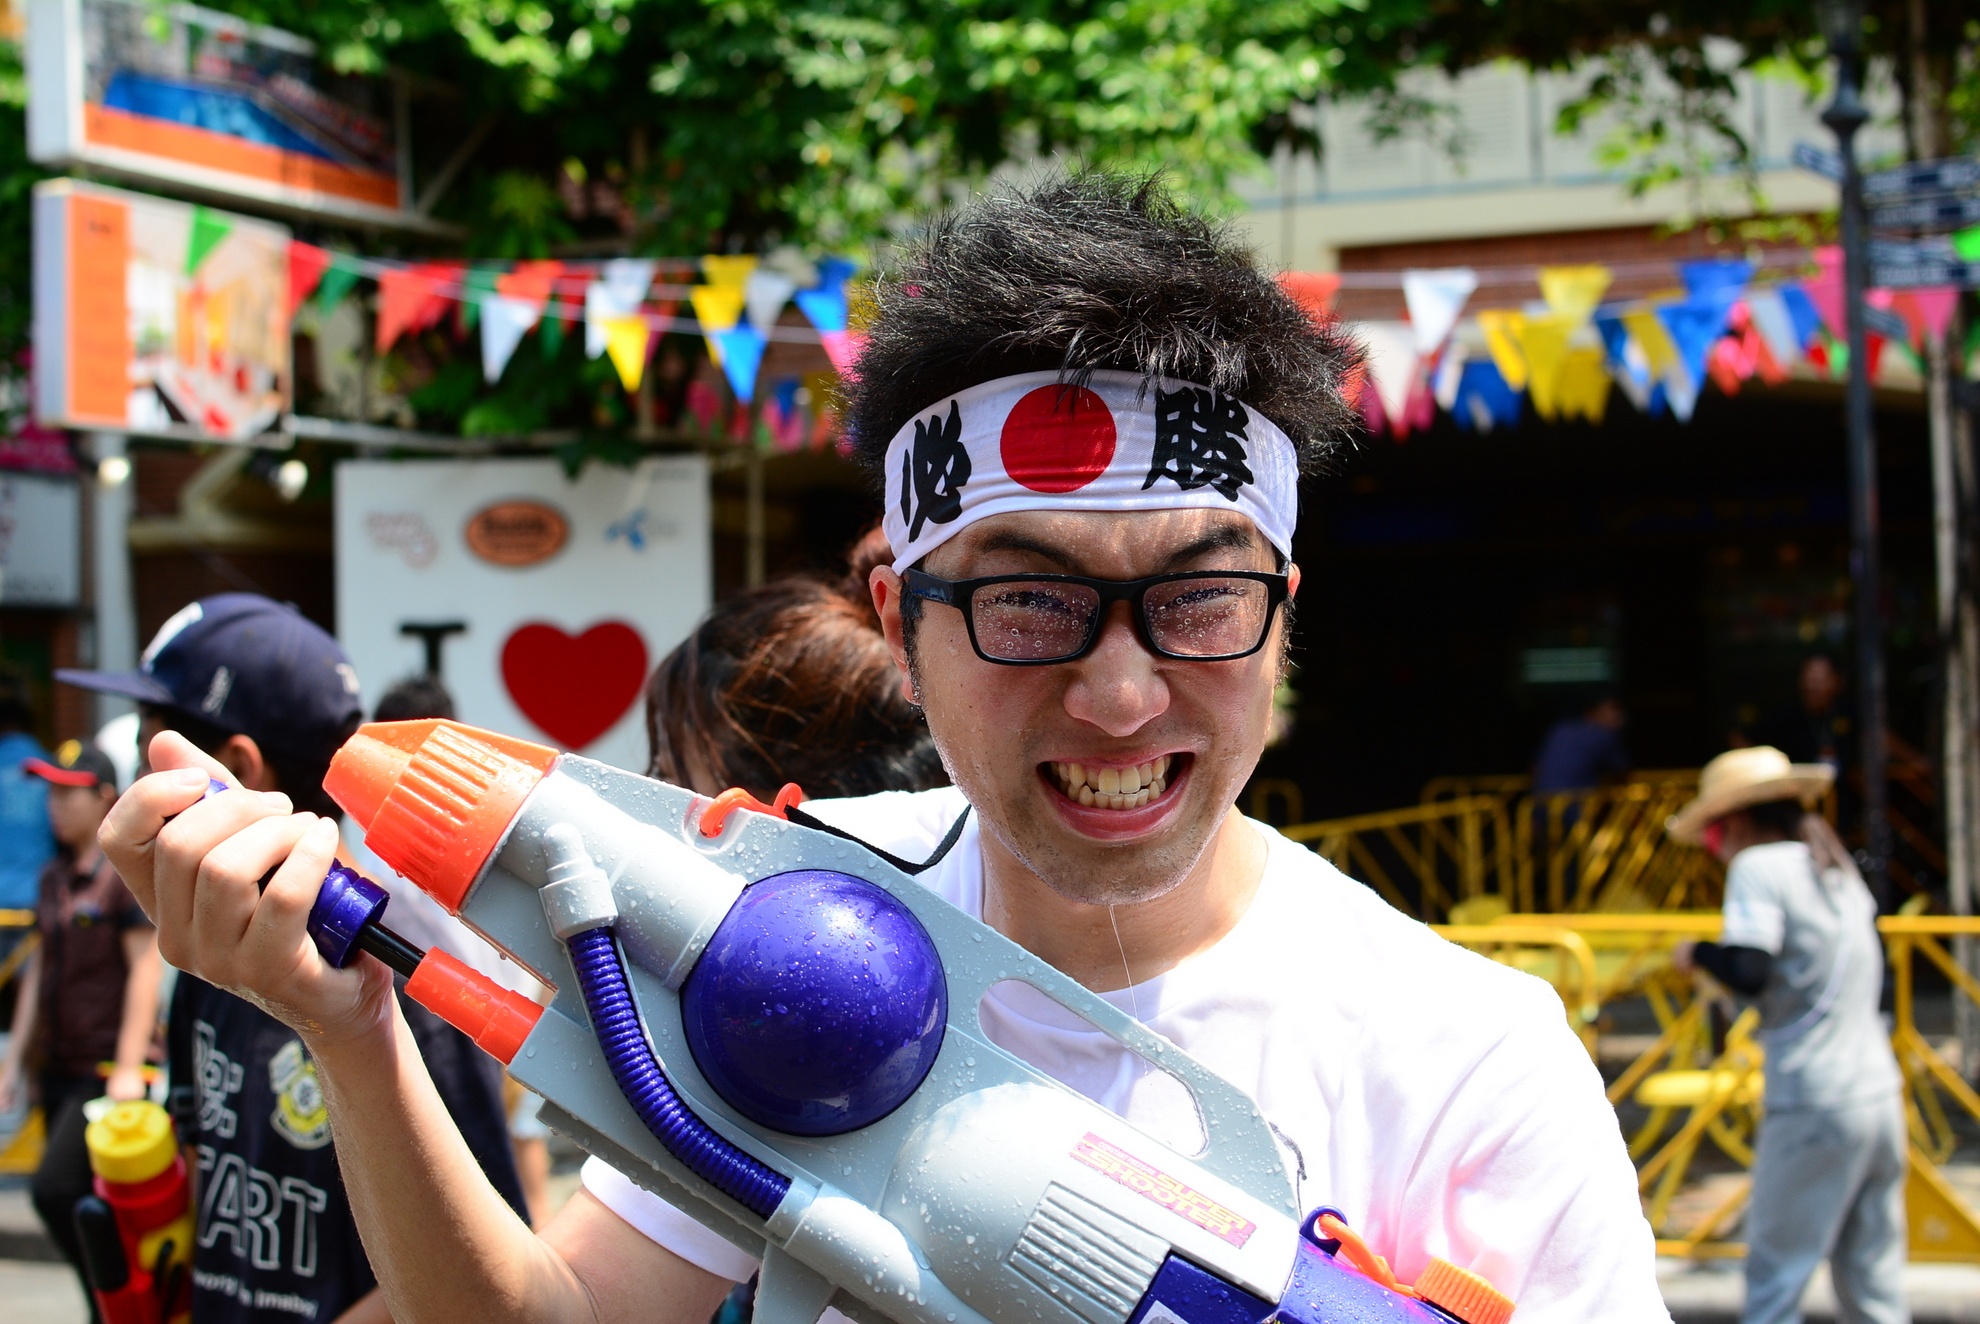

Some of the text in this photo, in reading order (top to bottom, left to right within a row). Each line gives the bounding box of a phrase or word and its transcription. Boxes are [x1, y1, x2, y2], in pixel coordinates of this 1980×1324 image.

[900, 386, 1254, 543] 必 勝
[1089, 1151, 1232, 1236] SHOOTER
[1157, 1172, 1248, 1230] SUPER
